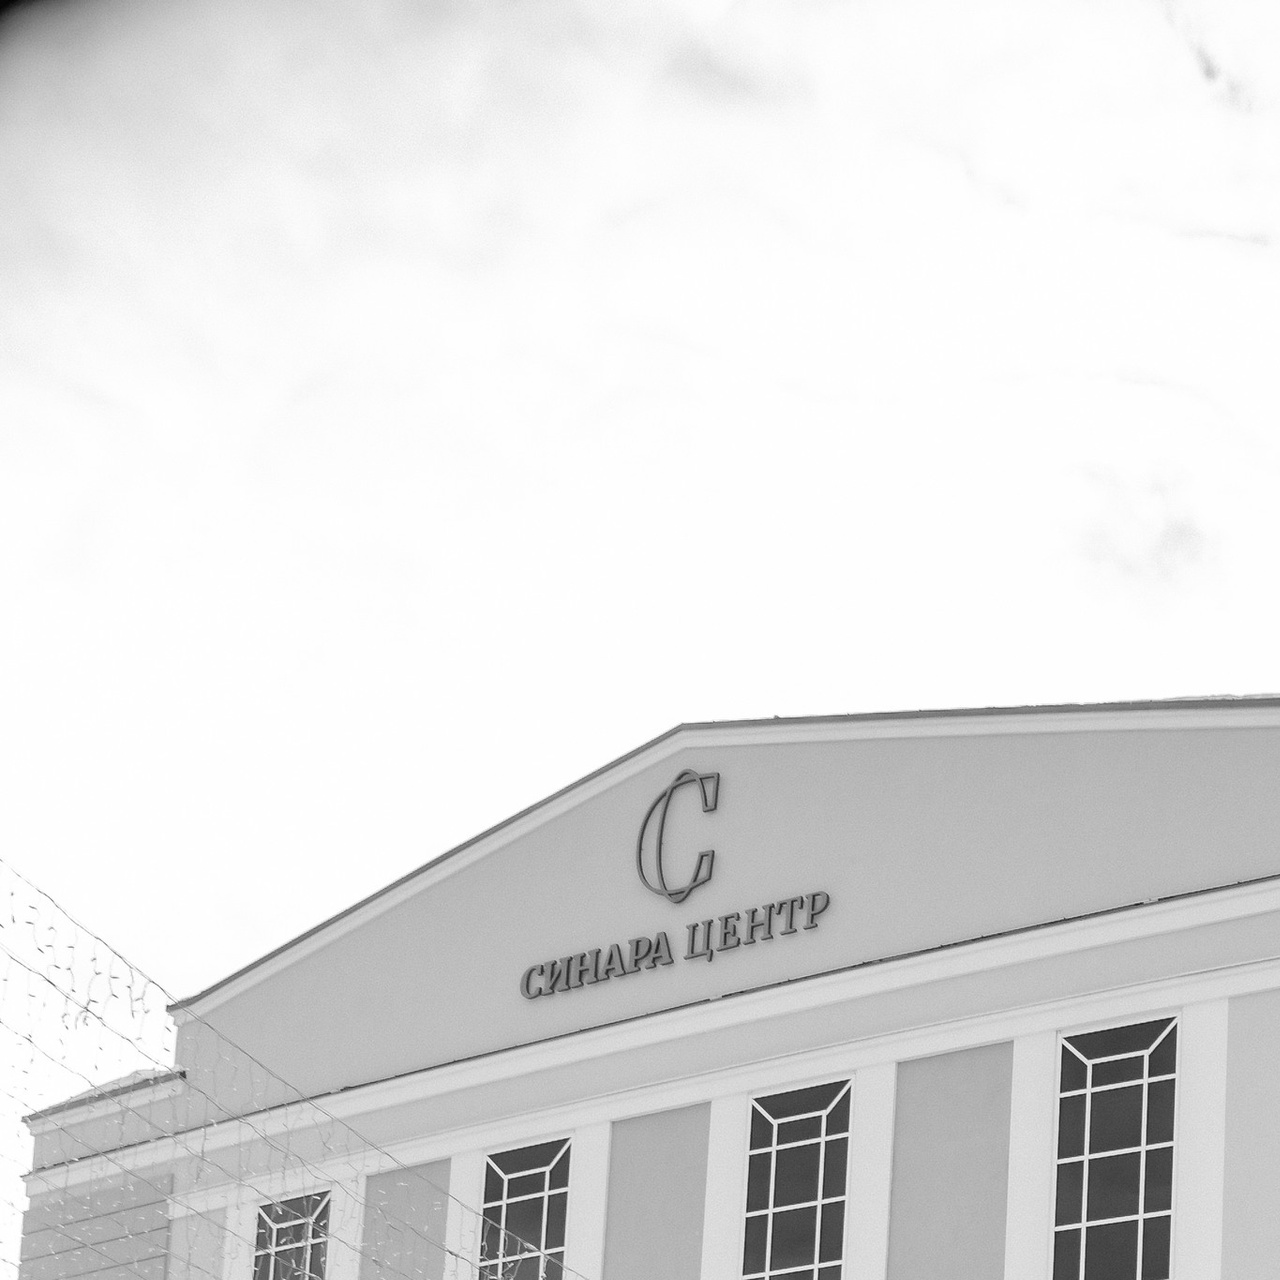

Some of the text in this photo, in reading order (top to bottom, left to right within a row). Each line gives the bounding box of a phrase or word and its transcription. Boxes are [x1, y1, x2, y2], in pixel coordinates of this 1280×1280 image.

[636, 768, 720, 904] С
[519, 891, 830, 1000] СИНАРА ЦЕНТР
